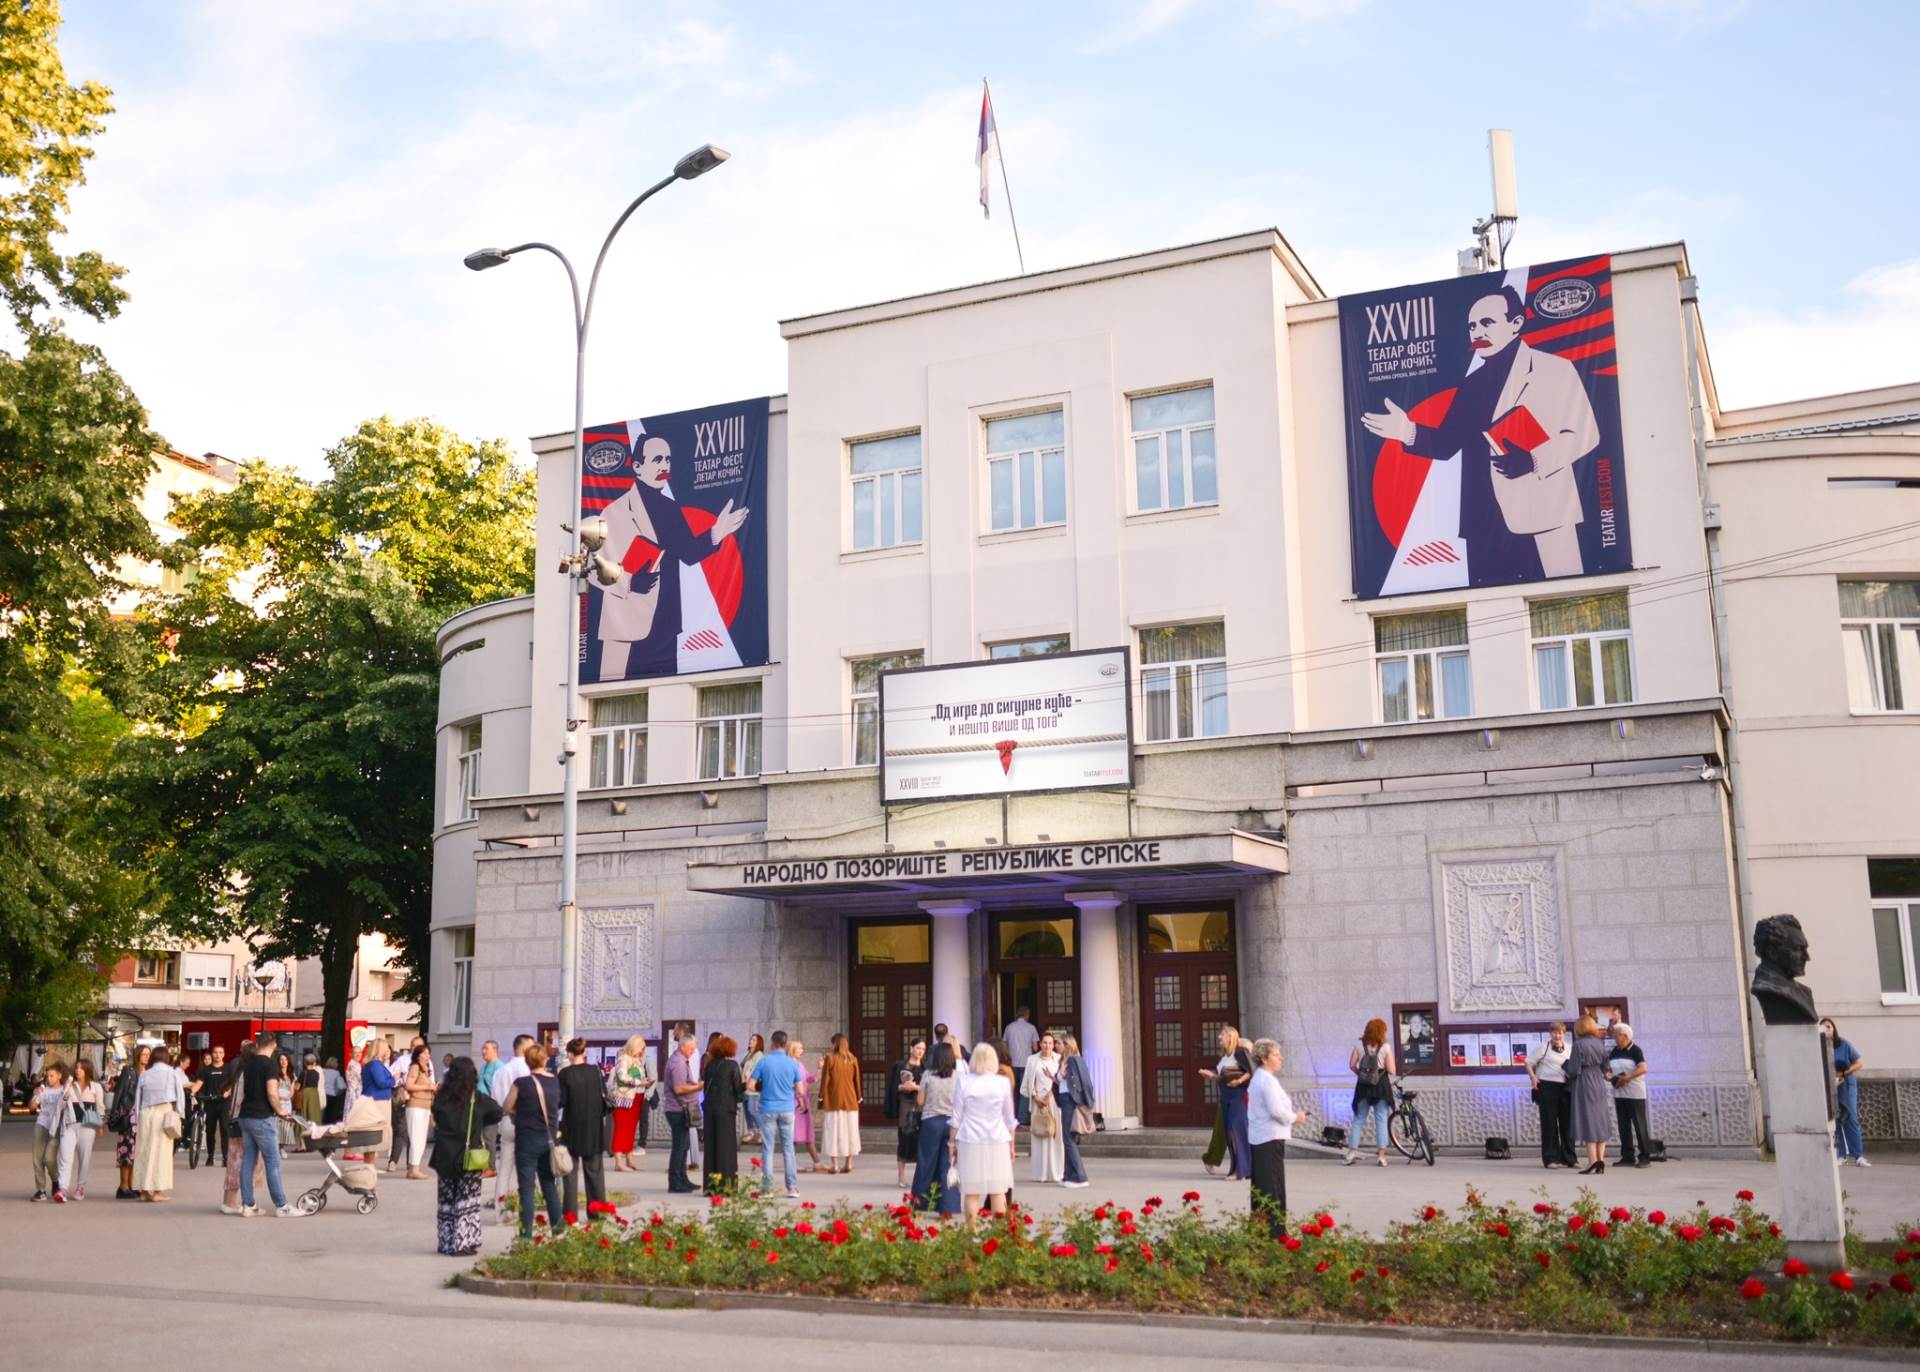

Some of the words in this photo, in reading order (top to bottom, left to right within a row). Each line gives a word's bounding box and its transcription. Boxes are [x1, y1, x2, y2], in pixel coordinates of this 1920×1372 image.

[1365, 296, 1436, 346] XXVIII
[1368, 345, 1404, 361] ТЕАТАР
[1407, 340, 1436, 356] ФЕСТ
[694, 415, 745, 458] XXVIII
[694, 458, 721, 472] ТЕАТАР
[723, 453, 744, 467] ФЕСТ
[930, 703, 951, 722] „Од
[953, 704, 977, 720] игре
[980, 702, 994, 718] до
[996, 698, 1042, 716] сигурне
[1044, 693, 1072, 713] куће
[949, 724, 956, 736] и
[958, 721, 989, 736] нешто
[992, 719, 1019, 733] више
[1021, 718, 1035, 733] од
[743, 862, 828, 884] НАРОДНО
[836, 855, 947, 879] ПОЗОРИШТЕ
[961, 848, 1073, 872] РЕПУБЛИКЕ
[1081, 843, 1160, 866] СРПСКЕ
